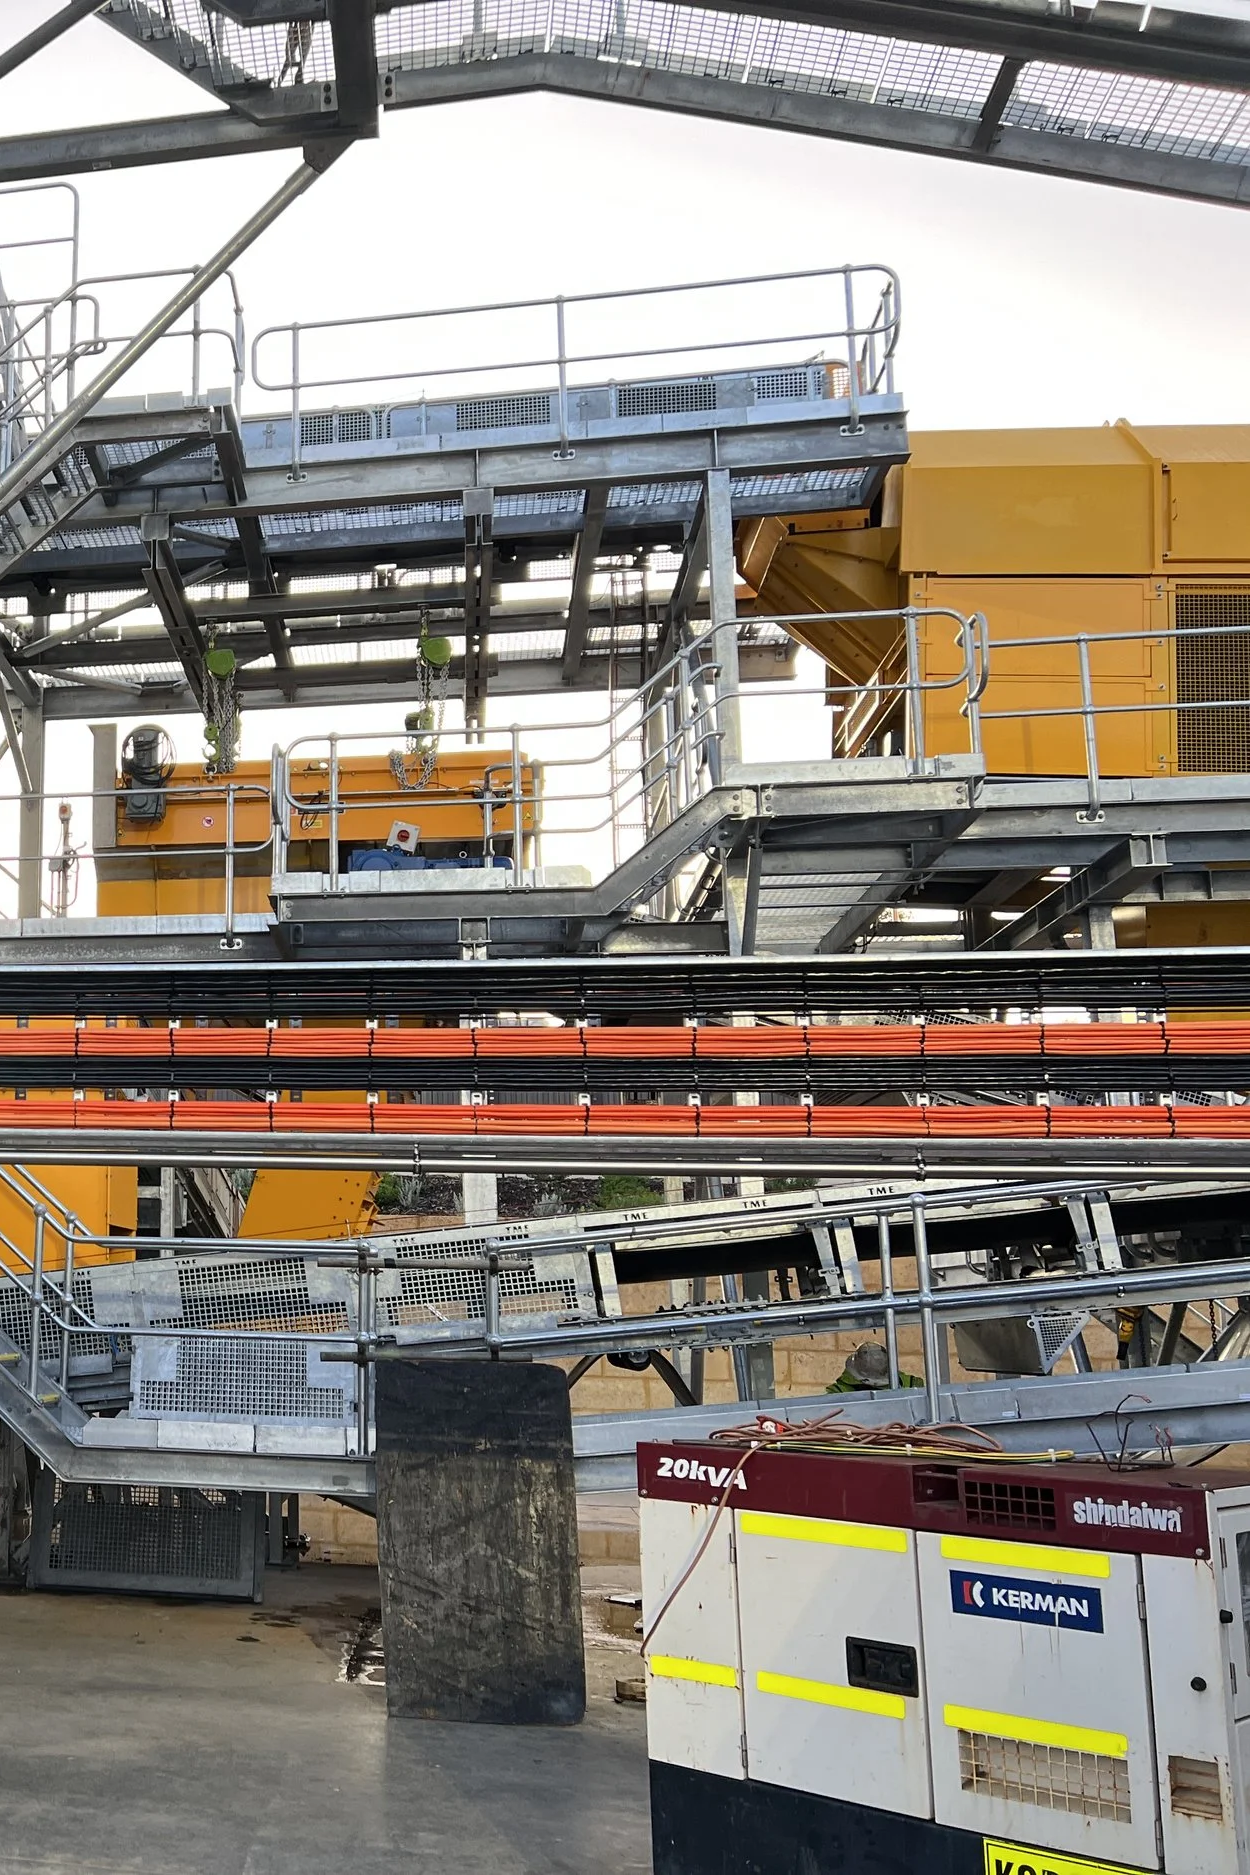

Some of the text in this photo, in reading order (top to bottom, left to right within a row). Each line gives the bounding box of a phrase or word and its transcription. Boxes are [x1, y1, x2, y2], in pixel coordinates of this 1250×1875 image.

[867, 1185, 895, 1196] TME
[742, 1199, 768, 1209] TME
[623, 1212, 649, 1222] TME
[657, 1457, 748, 1490] 20kVA
[1073, 1496, 1183, 1533] shindaiwa
[992, 1587, 1089, 1618] KERMAN
